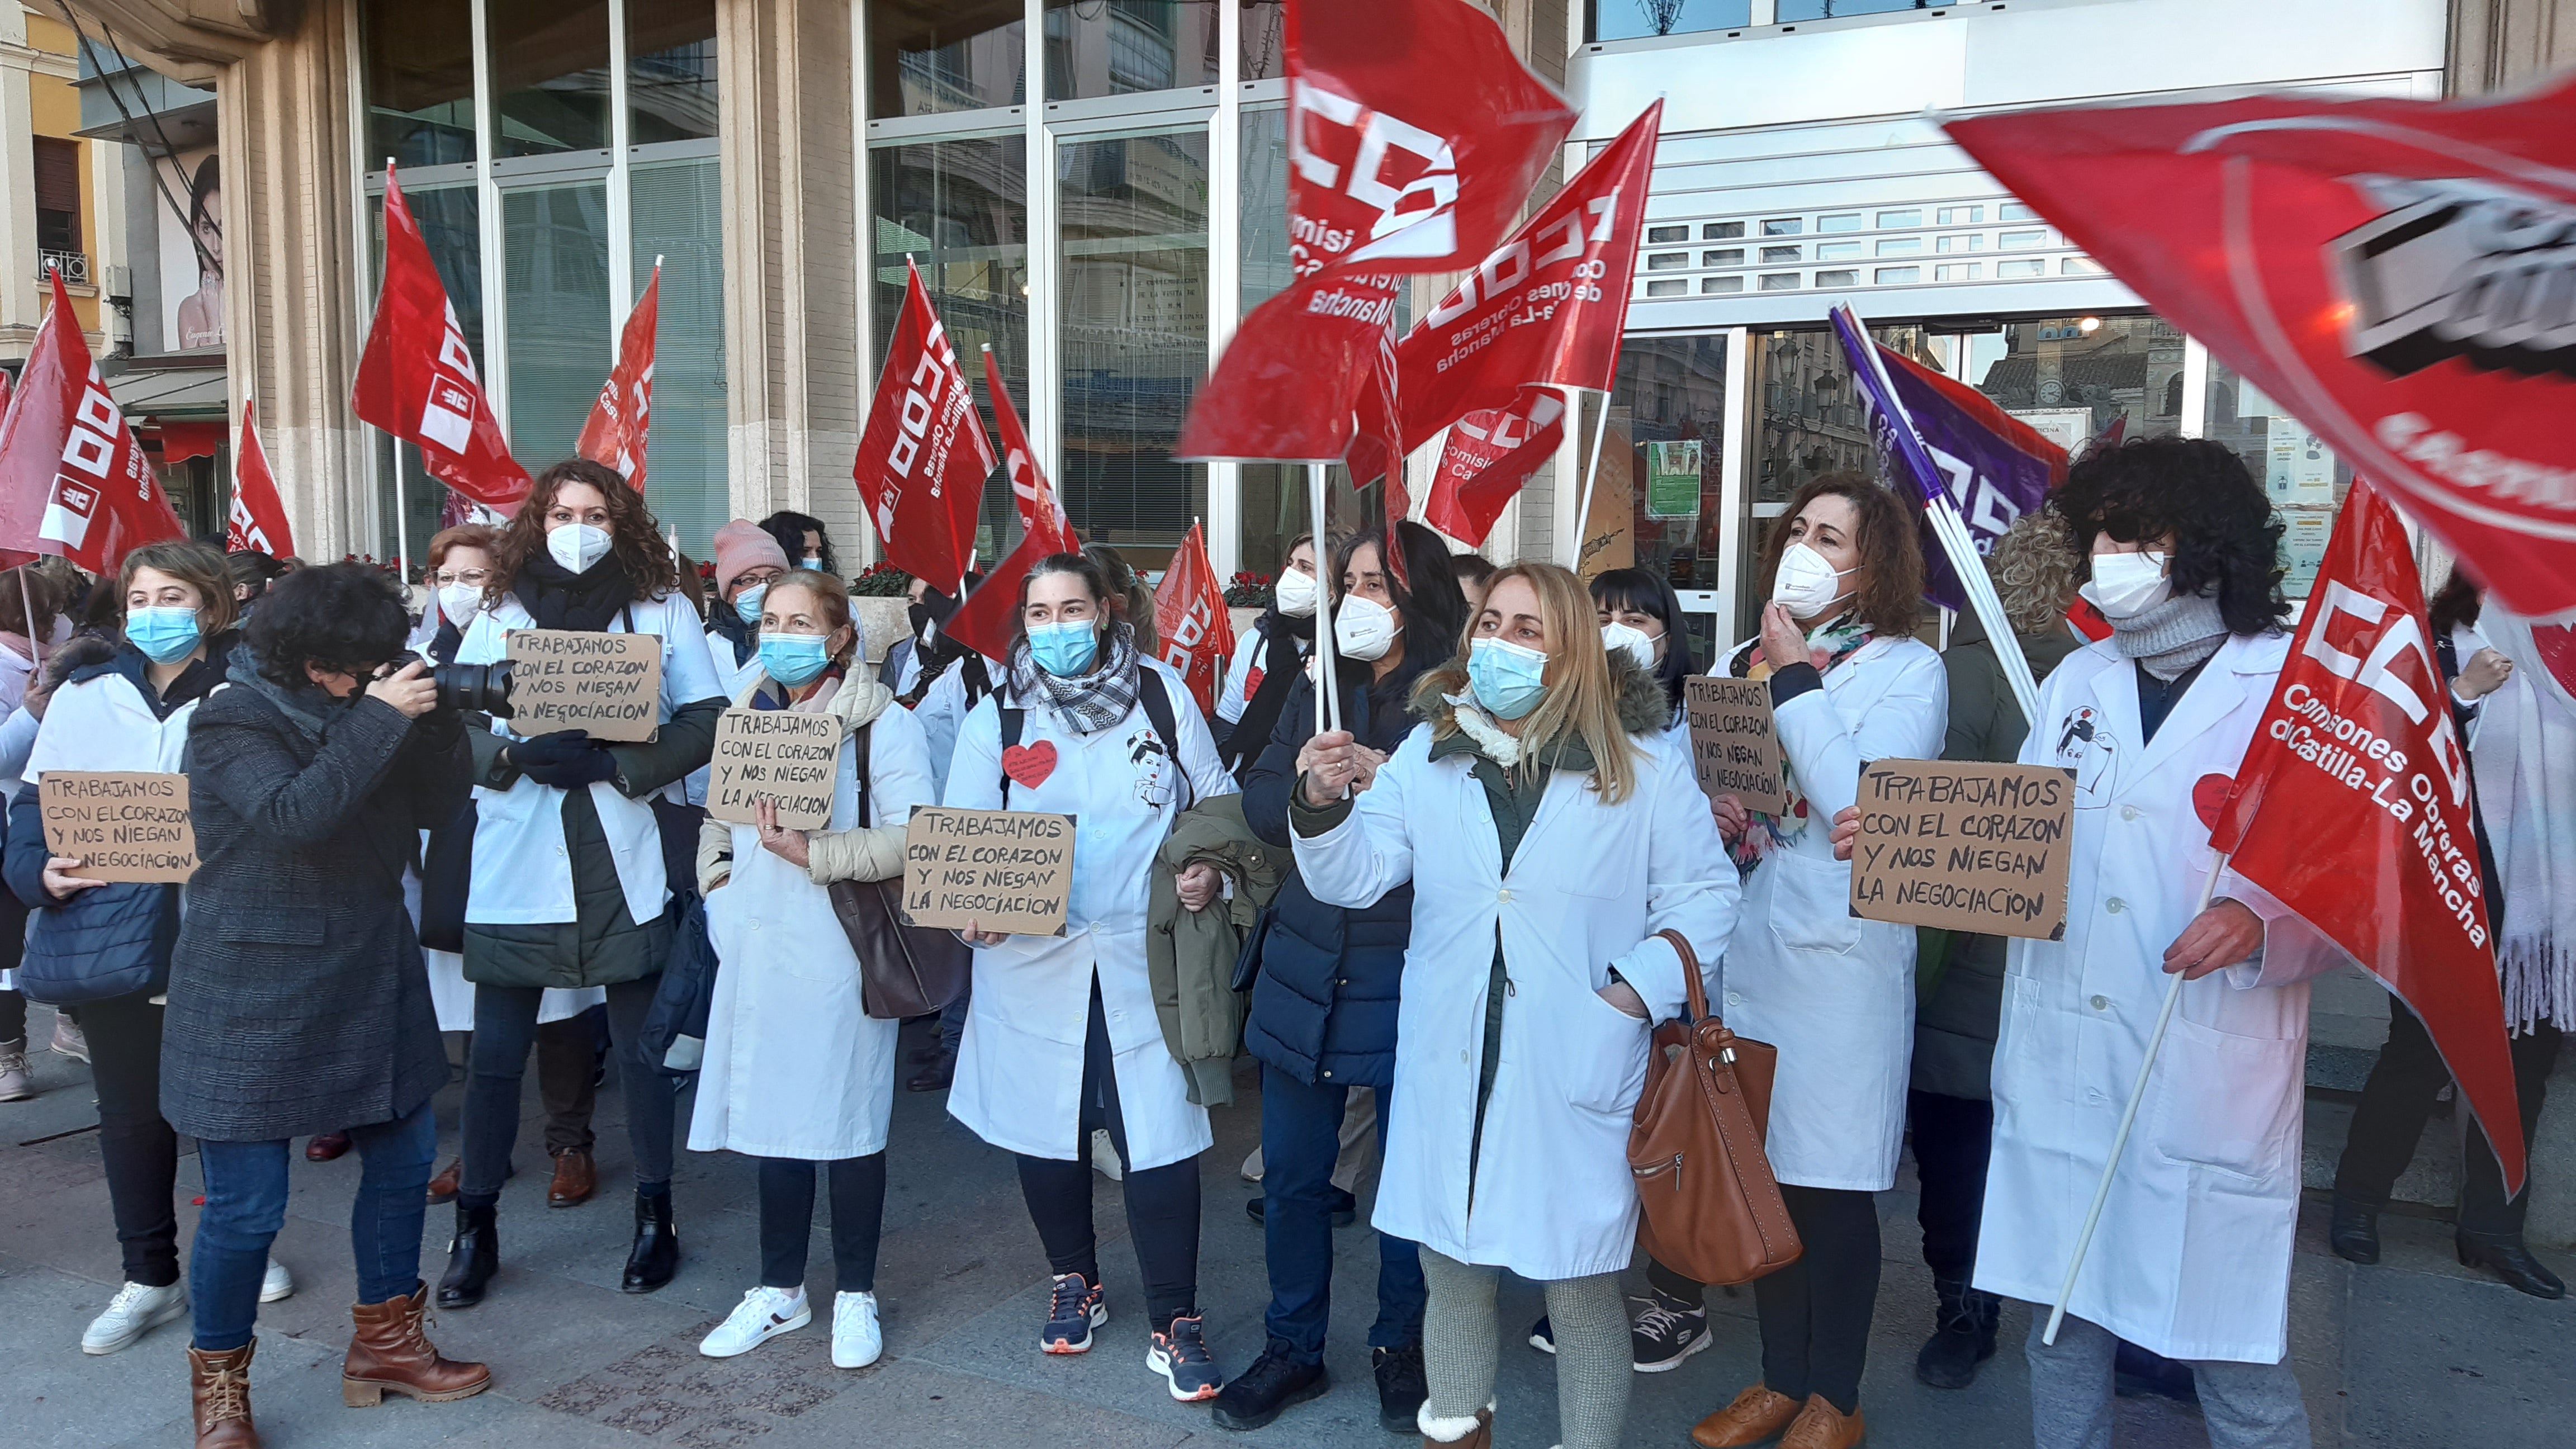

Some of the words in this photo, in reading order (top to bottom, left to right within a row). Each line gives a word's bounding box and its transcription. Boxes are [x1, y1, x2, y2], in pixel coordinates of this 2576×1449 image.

[513, 659, 541, 678] CON
[544, 659, 565, 675] EL
[572, 659, 649, 676] CORAZON
[527, 678, 565, 697] NOS
[1689, 683, 1762, 707] TRABAJAMOS
[727, 714, 830, 738] TRABAJAMOS
[1690, 711, 1707, 730] CON
[1710, 713, 1722, 732] EL
[1723, 714, 1768, 740] CORAZON
[721, 740, 752, 759] CON
[755, 742, 772, 759] EL
[777, 742, 837, 761] CORAZON
[1696, 739, 1704, 759] Y
[1706, 740, 1723, 759] NOS
[721, 765, 733, 785] Y
[741, 763, 766, 781] NOS
[1700, 764, 1712, 783] LA
[47, 778, 174, 799] TRABAJAMOS
[721, 788, 741, 807] LA
[1869, 771, 2062, 810] TRABAJAMOS
[46, 806, 91, 822] CON
[52, 826, 64, 845] Y
[73, 827, 105, 844] NOS
[924, 813, 1062, 839] TRABAJAMOS
[1863, 812, 1911, 836] CON
[1918, 812, 1950, 837] EL
[1960, 812, 2066, 844] CORAZON
[2411, 773, 2481, 898] Obreras
[908, 844, 941, 862] CON
[945, 844, 968, 863] EL
[973, 847, 1063, 865] CORAZON
[1864, 843, 1886, 872] Y
[1889, 846, 1936, 870] NOS
[917, 868, 932, 885] Y
[943, 868, 977, 886] NOS
[2413, 819, 2487, 950] Mancha
[910, 890, 932, 910] LA
[1857, 876, 1884, 905] LA
